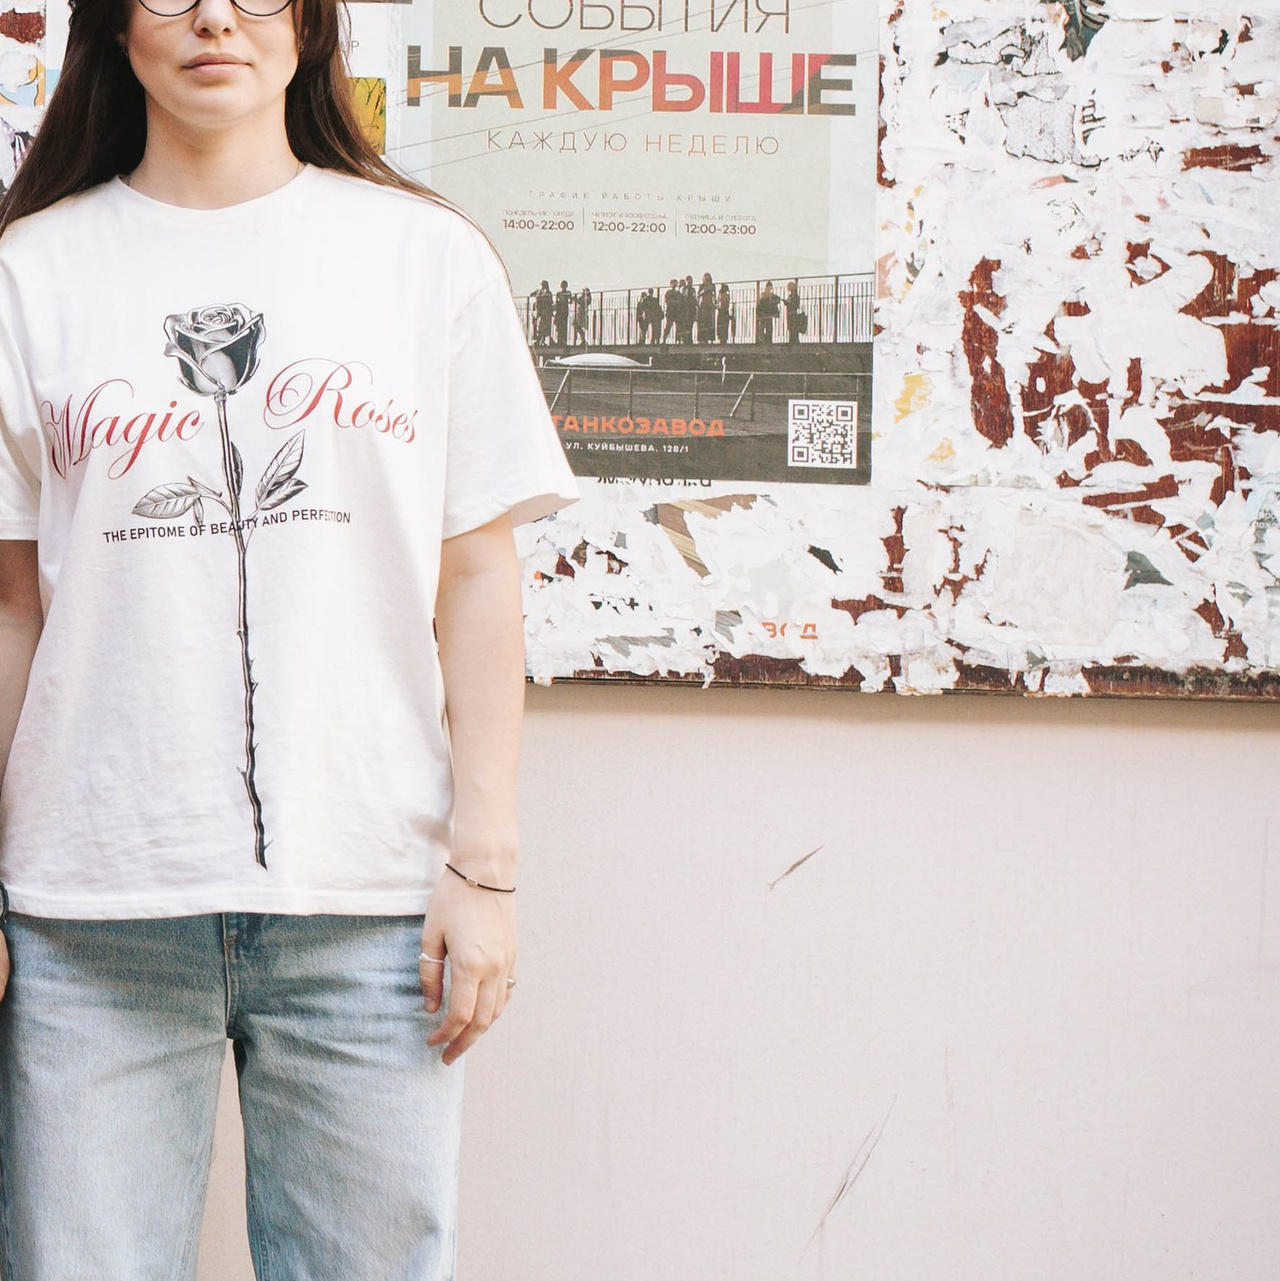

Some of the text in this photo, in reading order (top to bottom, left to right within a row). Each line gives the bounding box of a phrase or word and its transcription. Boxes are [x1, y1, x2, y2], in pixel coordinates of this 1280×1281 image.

[407, 45, 856, 116] НА КРЫШЕ
[487, 130, 780, 156] КАЖДУЮ НЕДЕЛЮ
[503, 219, 574, 231] 14:00-22:00
[592, 221, 666, 233] 12:00-22:00
[685, 223, 757, 235] 12:00-23:00
[264, 358, 418, 443] Roses
[40, 378, 205, 480] Magic
[552, 414, 725, 436] ТАНКОЗАВОД
[565, 442, 583, 451] УЛ.
[663, 445, 689, 453] 128/1
[103, 529, 127, 543] THE
[131, 526, 185, 540] EPITOME
[189, 525, 207, 537] OF
[210, 517, 258, 534] BEAUTY
[262, 512, 287, 527] AND
